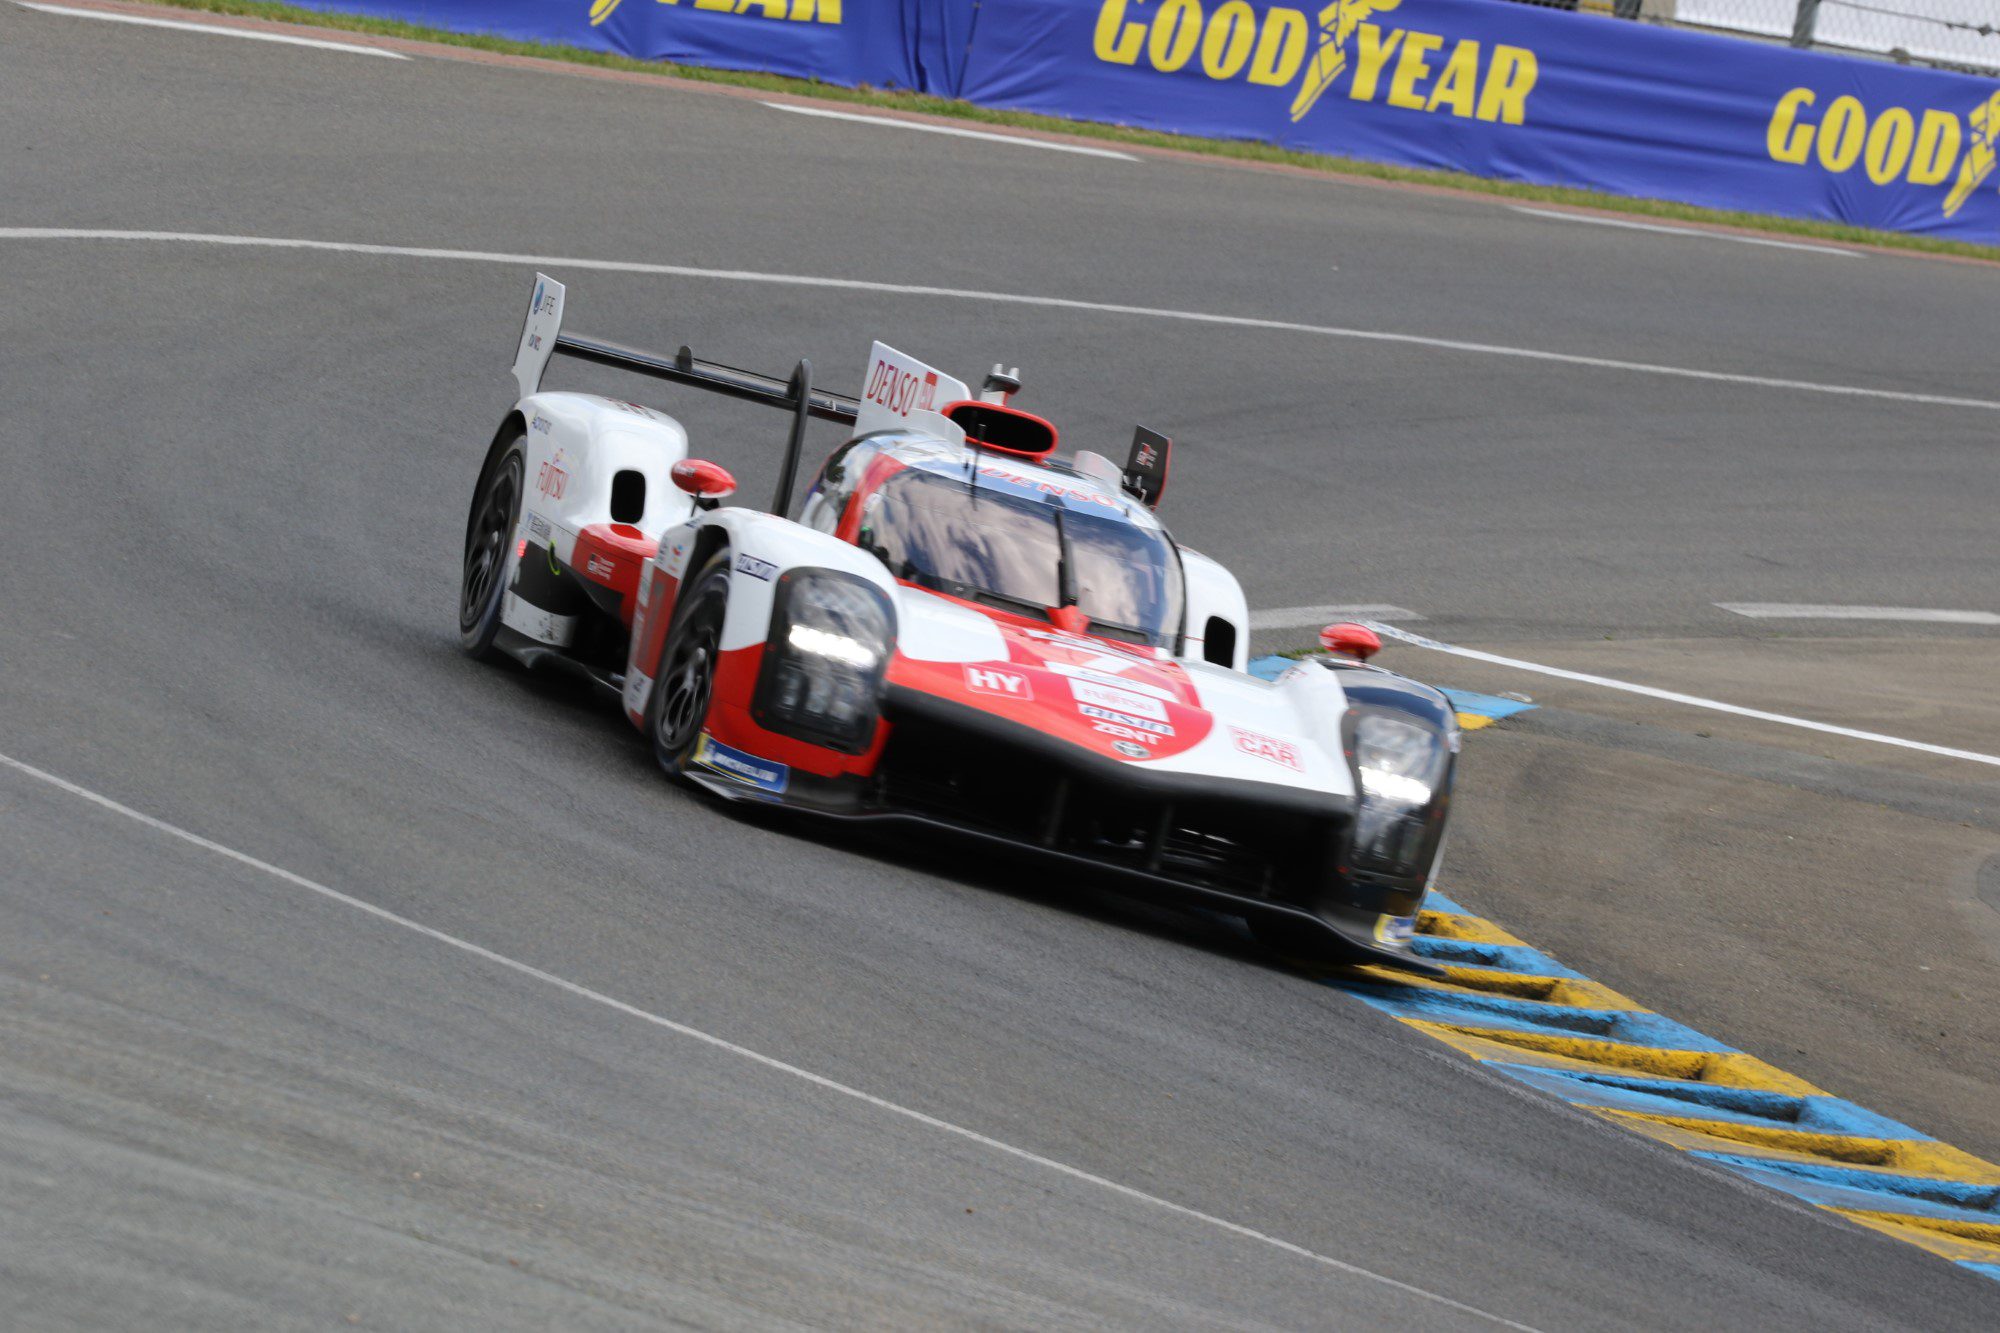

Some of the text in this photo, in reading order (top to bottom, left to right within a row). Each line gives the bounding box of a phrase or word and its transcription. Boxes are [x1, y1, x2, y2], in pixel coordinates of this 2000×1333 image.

[1350, 22, 1539, 126] YEAR
[1766, 87, 1962, 186] GOOD
[866, 359, 919, 417] DENSO
[976, 467, 1116, 507] DENSO
[968, 667, 1022, 693] HY
[1236, 737, 1298, 768] CAR
